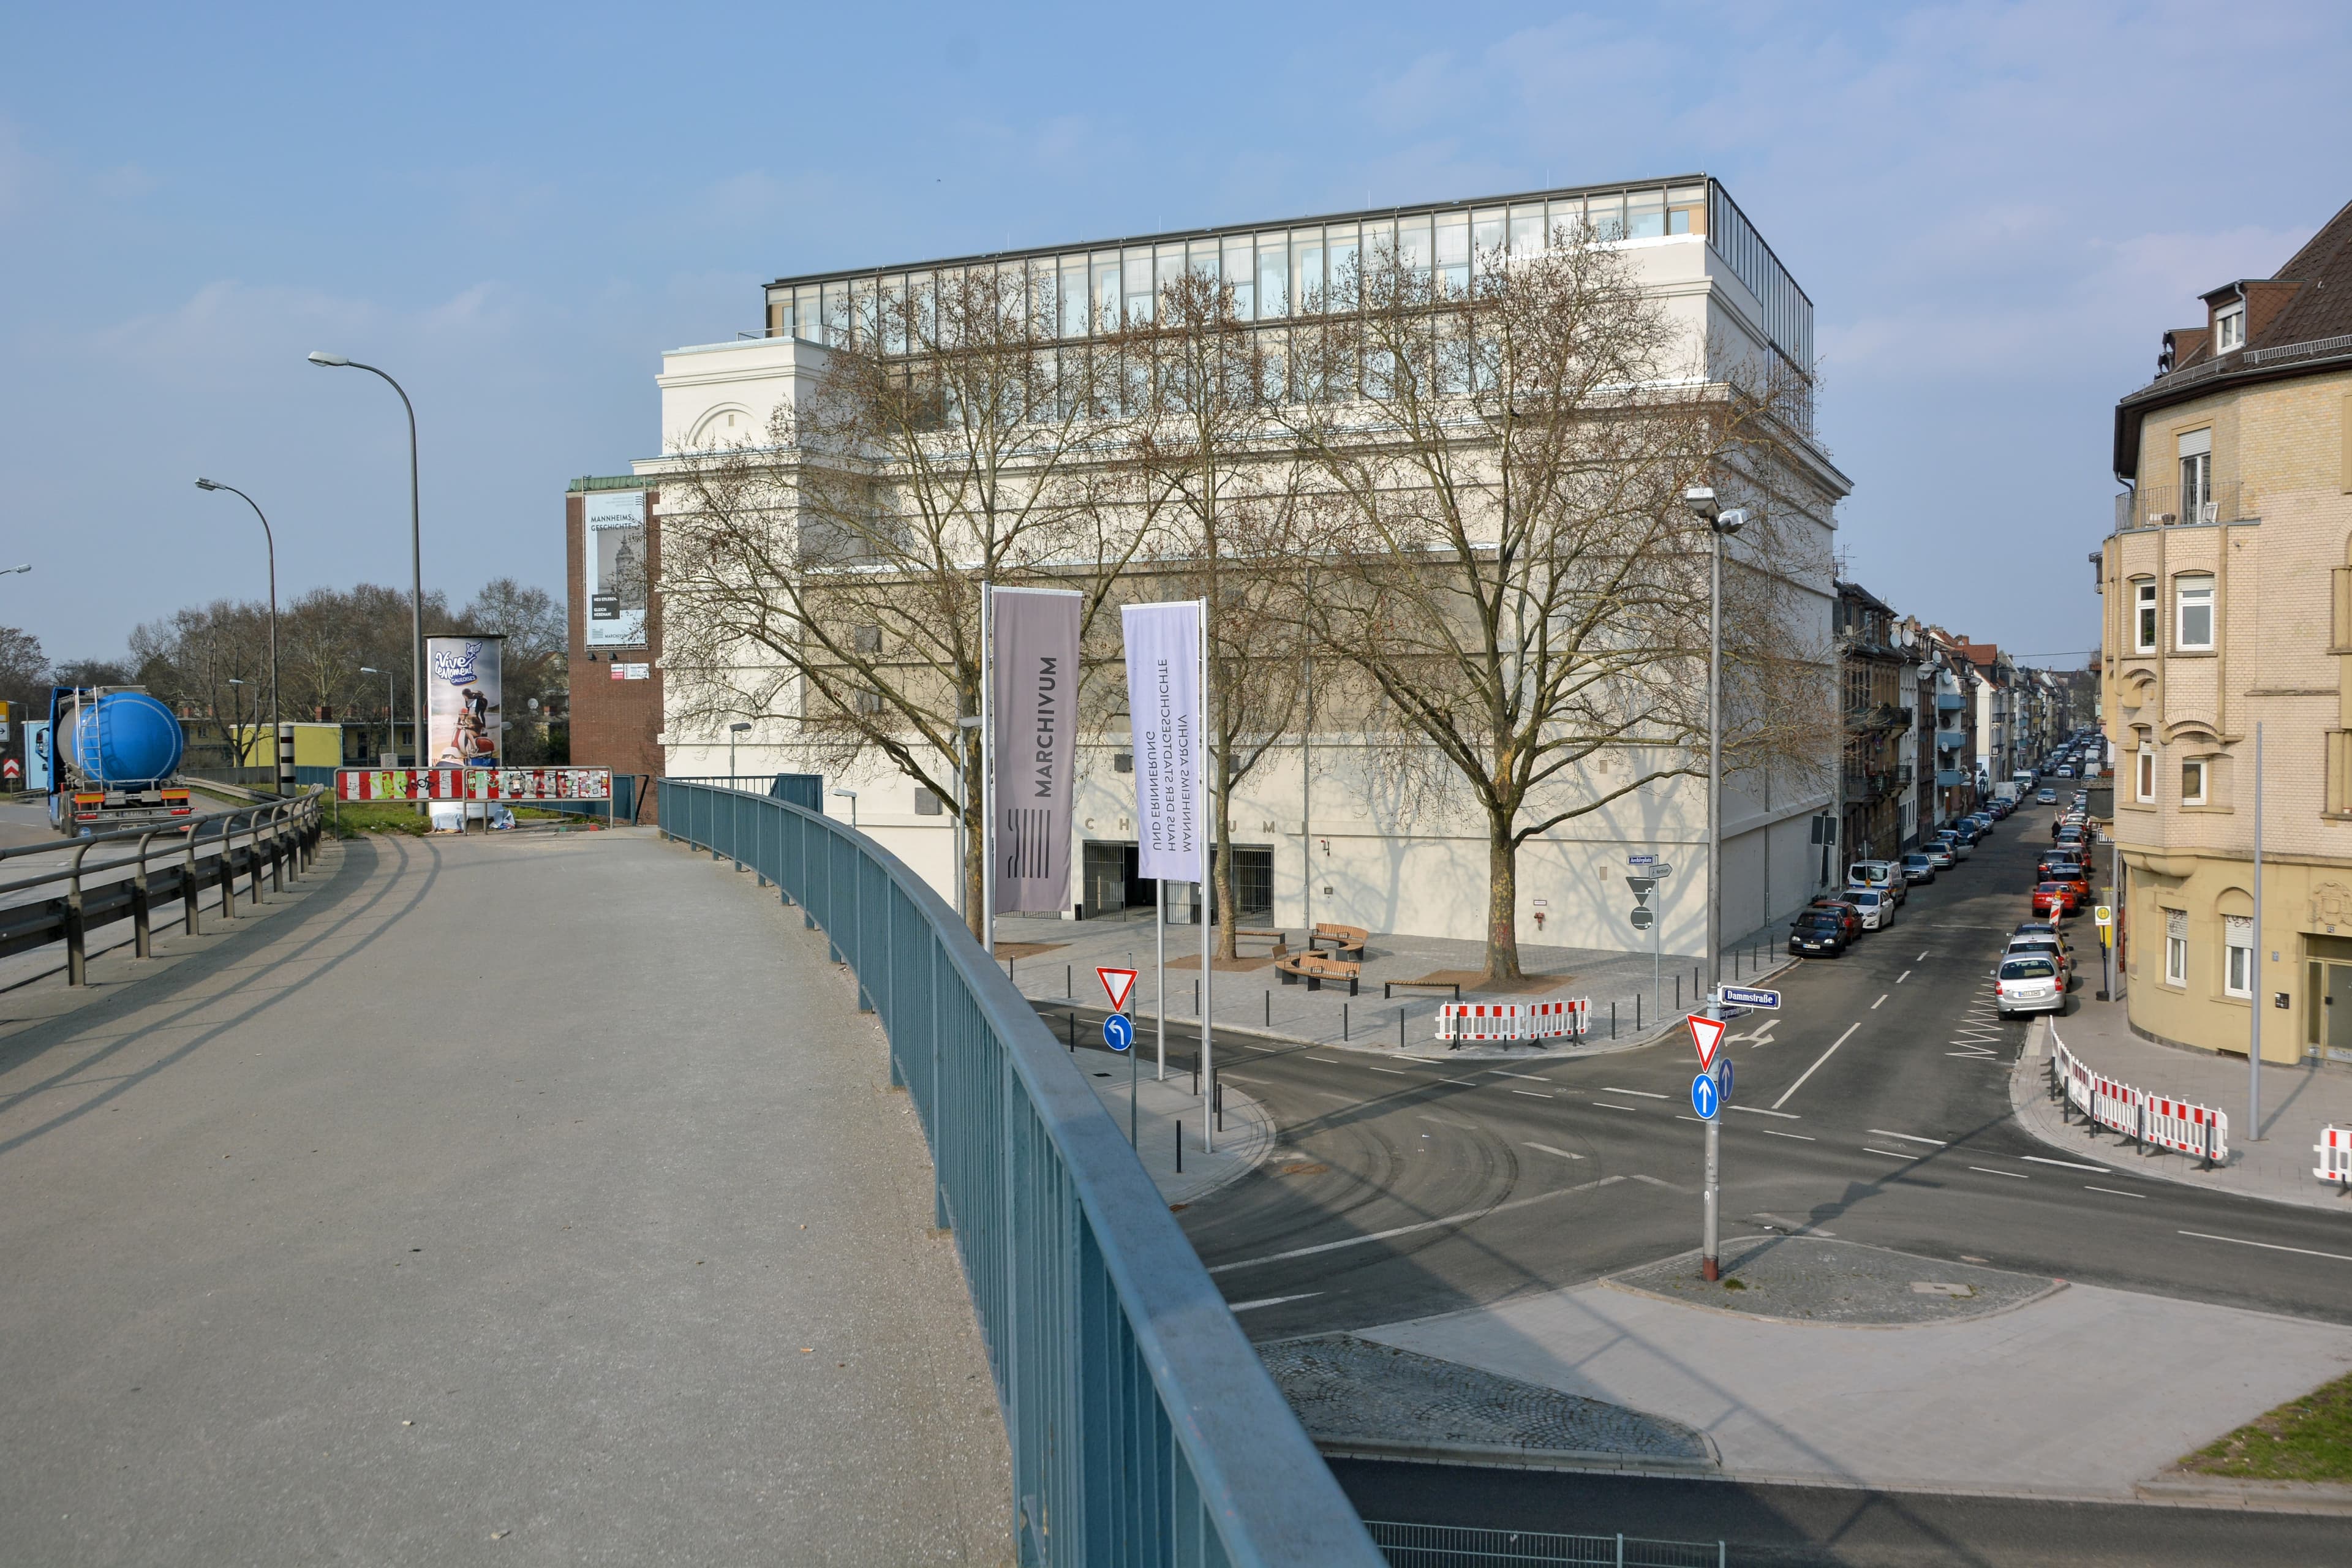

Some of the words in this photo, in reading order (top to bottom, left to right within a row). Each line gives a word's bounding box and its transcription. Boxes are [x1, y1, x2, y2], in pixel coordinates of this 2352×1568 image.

[590, 514, 631, 522] MANNHEIMS
[435, 651, 476, 668] Vive
[1035, 657, 1057, 797] MARCHIVUM
[1727, 990, 1773, 1004] Dammstraße
